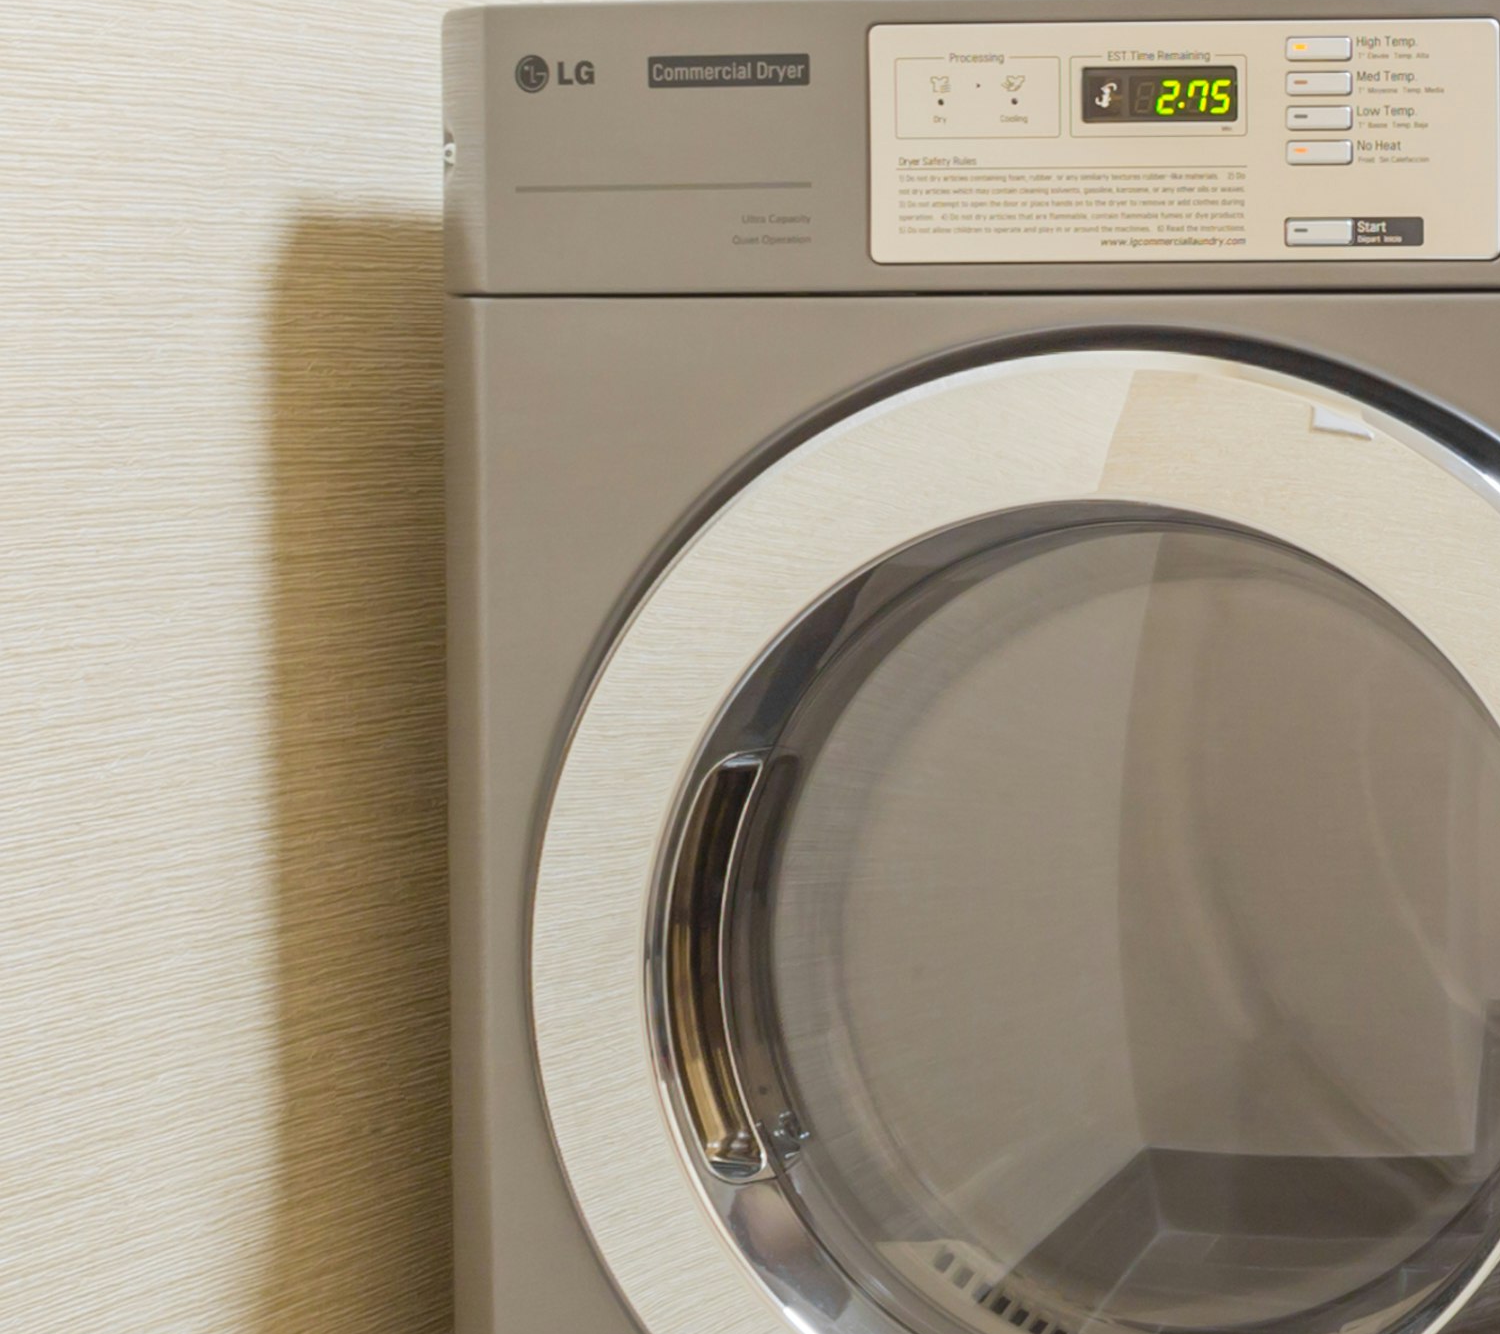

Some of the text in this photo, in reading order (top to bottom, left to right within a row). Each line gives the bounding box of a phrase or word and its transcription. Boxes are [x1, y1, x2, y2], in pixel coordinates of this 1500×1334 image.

[1356, 36, 1381, 50] High
[949, 52, 1004, 64] Processing
[1158, 51, 1211, 62] Remaining
[557, 60, 596, 86] LG
[652, 61, 805, 83] Commercial Dryer
[1357, 71, 1380, 82] Med
[1155, 79, 1231, 115] 2.75
[1357, 106, 1380, 116] Low
[1357, 140, 1401, 151] No Heat
[898, 156, 977, 167] Dryer Safety Rules
[1357, 221, 1387, 233] Start
